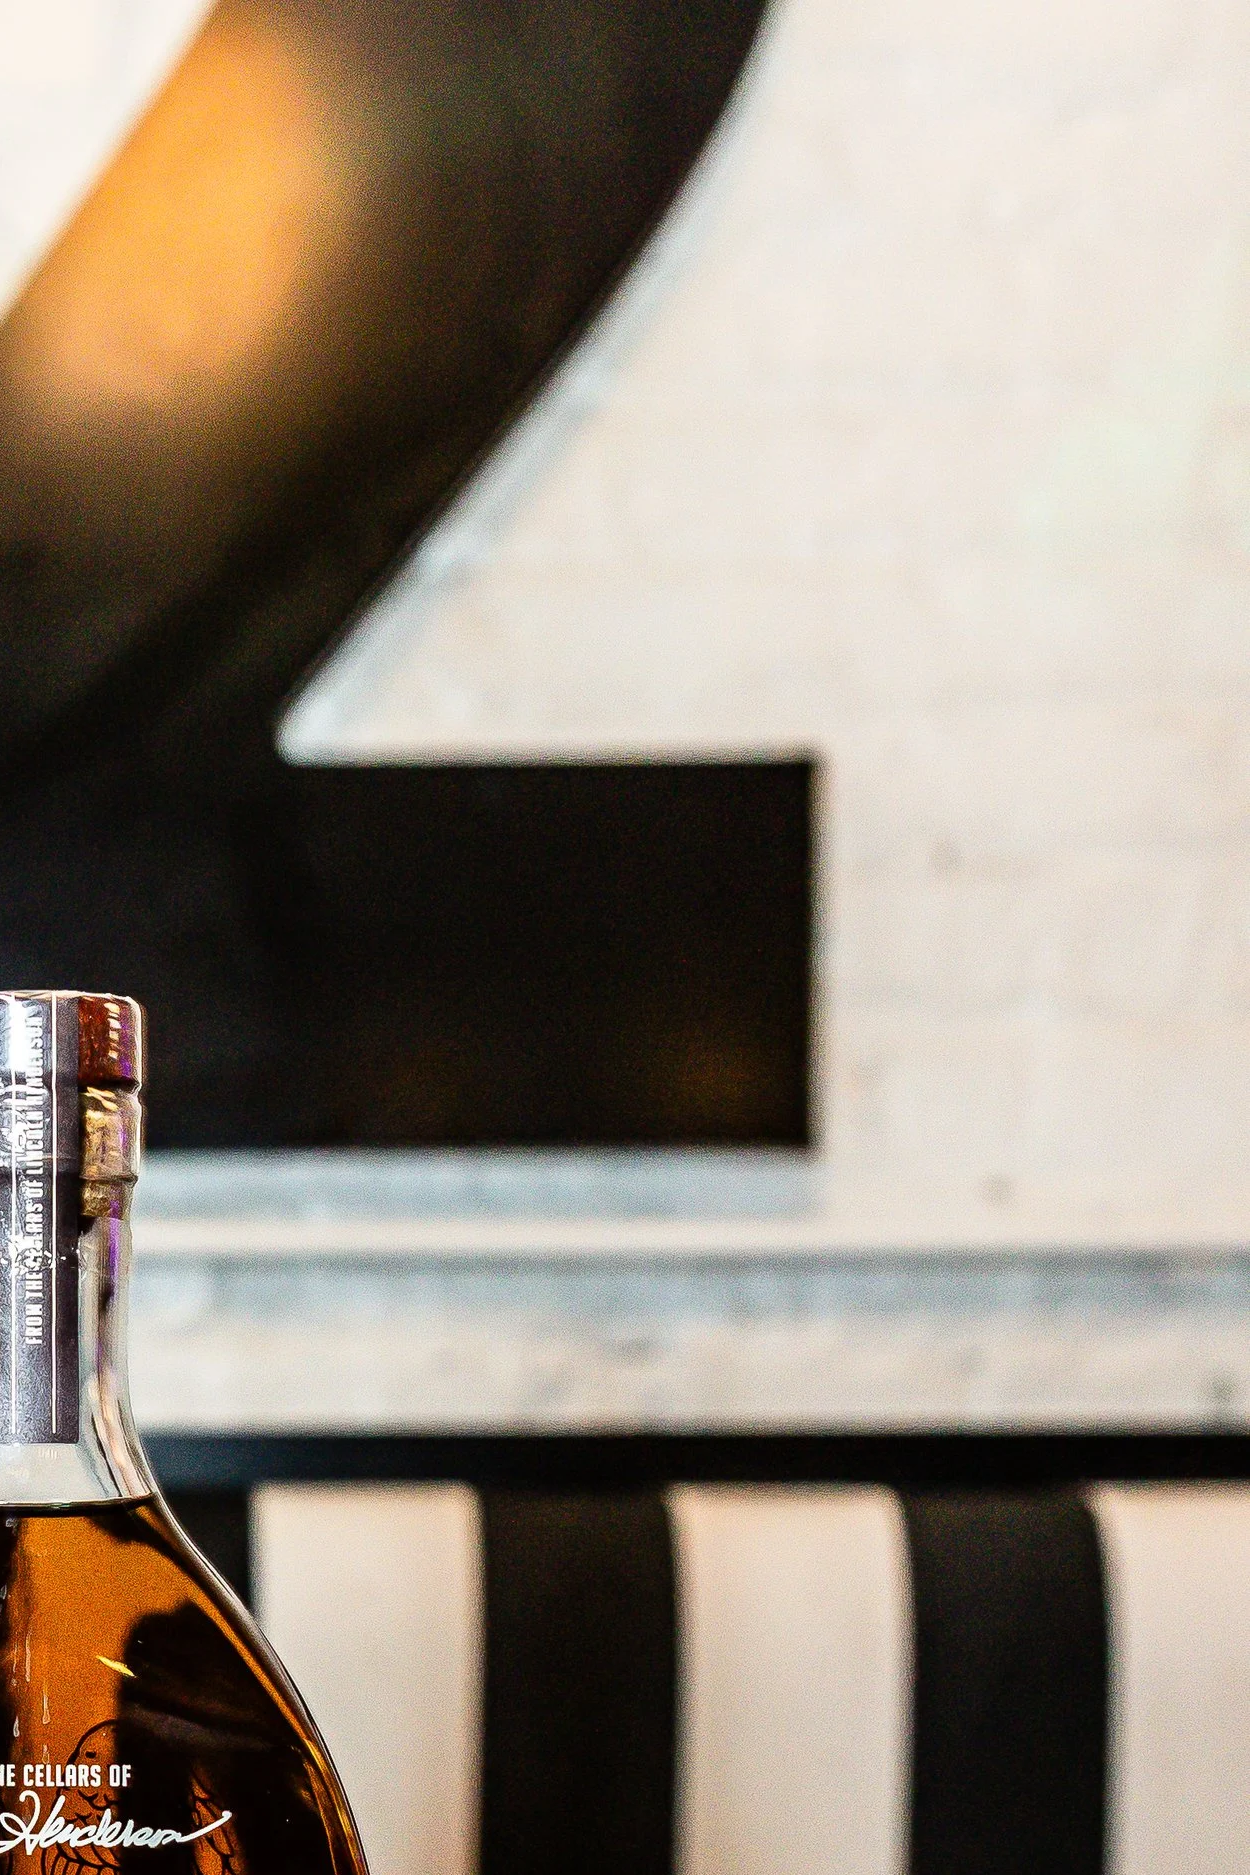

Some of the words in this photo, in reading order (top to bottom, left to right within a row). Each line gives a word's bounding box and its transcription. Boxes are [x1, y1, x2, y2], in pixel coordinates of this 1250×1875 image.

[24, 1179, 43, 1199] OF
[25, 1272, 43, 1299] THE
[25, 1304, 43, 1345] FROM
[23, 1763, 102, 1787] CELLARS
[109, 1763, 132, 1787] OF
